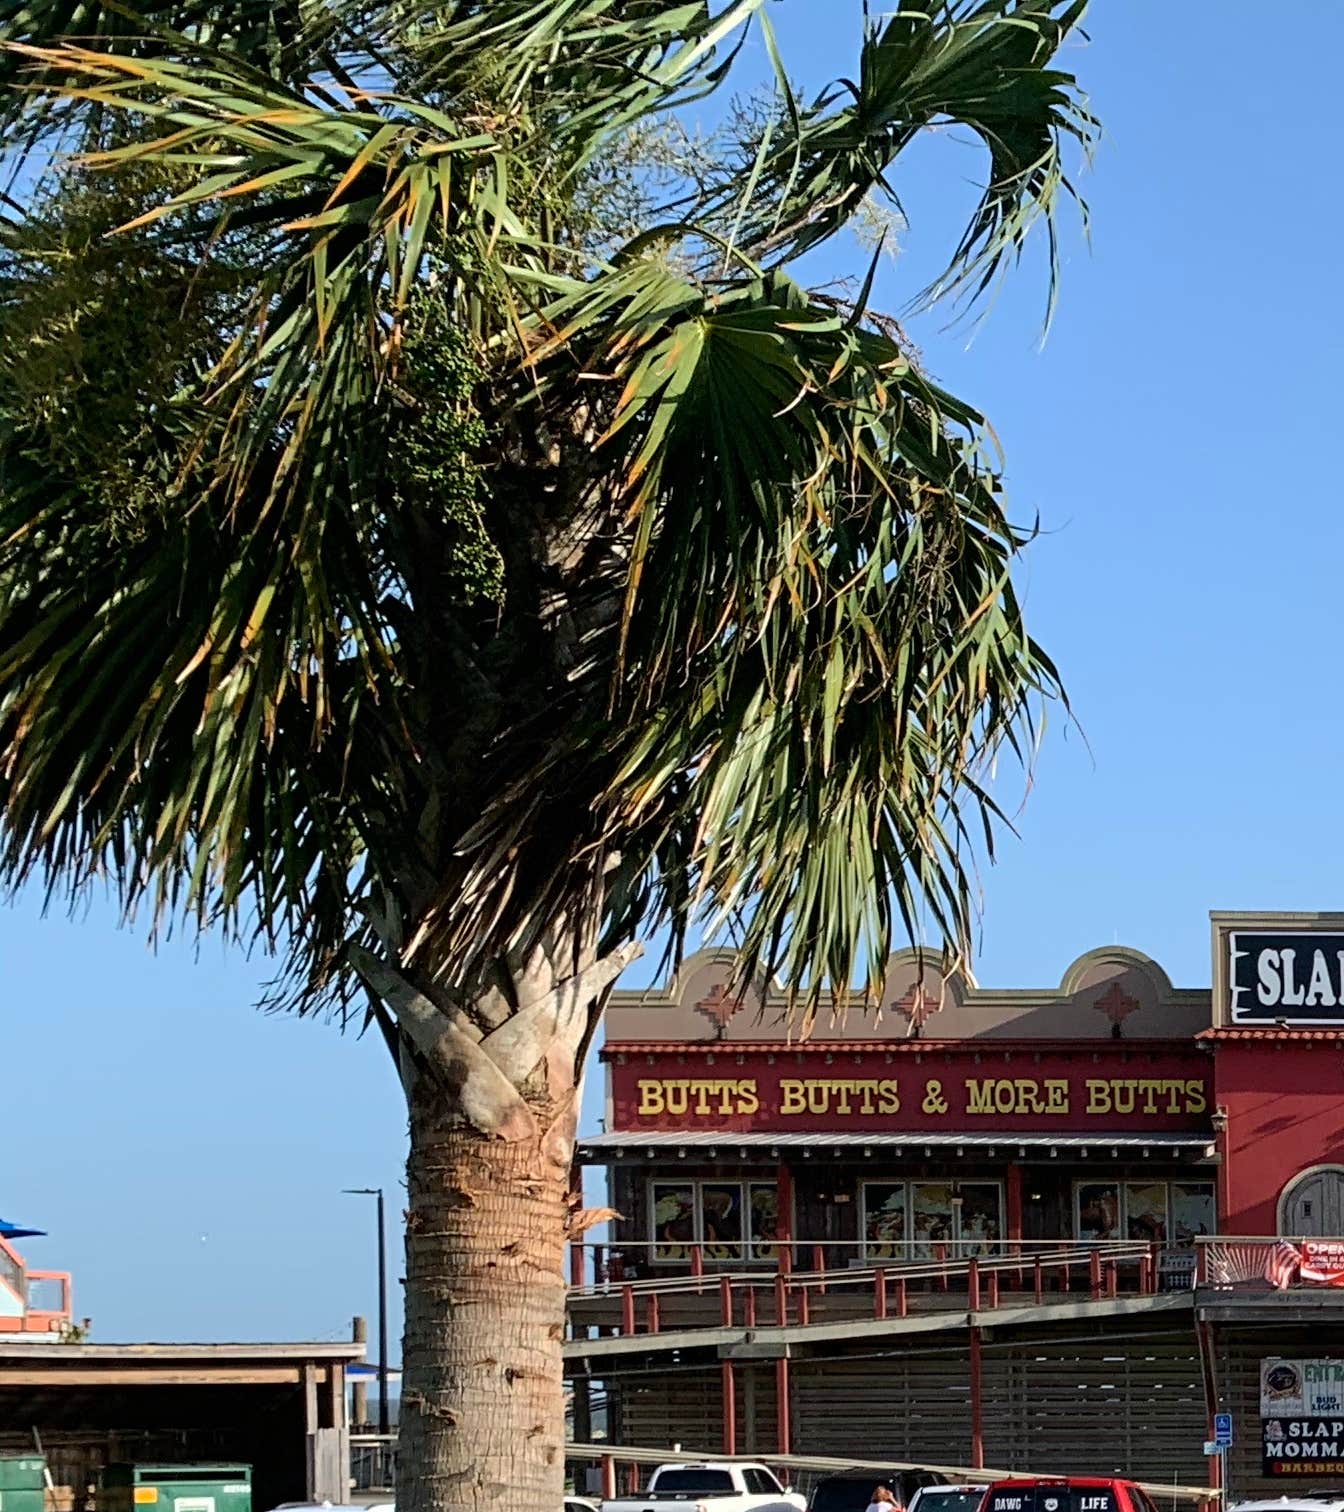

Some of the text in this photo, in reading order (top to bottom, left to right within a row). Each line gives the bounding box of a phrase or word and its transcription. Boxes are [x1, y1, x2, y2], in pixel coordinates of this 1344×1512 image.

[638, 1079, 1206, 1115] BUTTS BUTTS & MORE BUTTS
[1289, 1422, 1344, 1437] SLAP
[994, 1498, 1021, 1511] DAWG
[1081, 1497, 1108, 1510] LIFE
